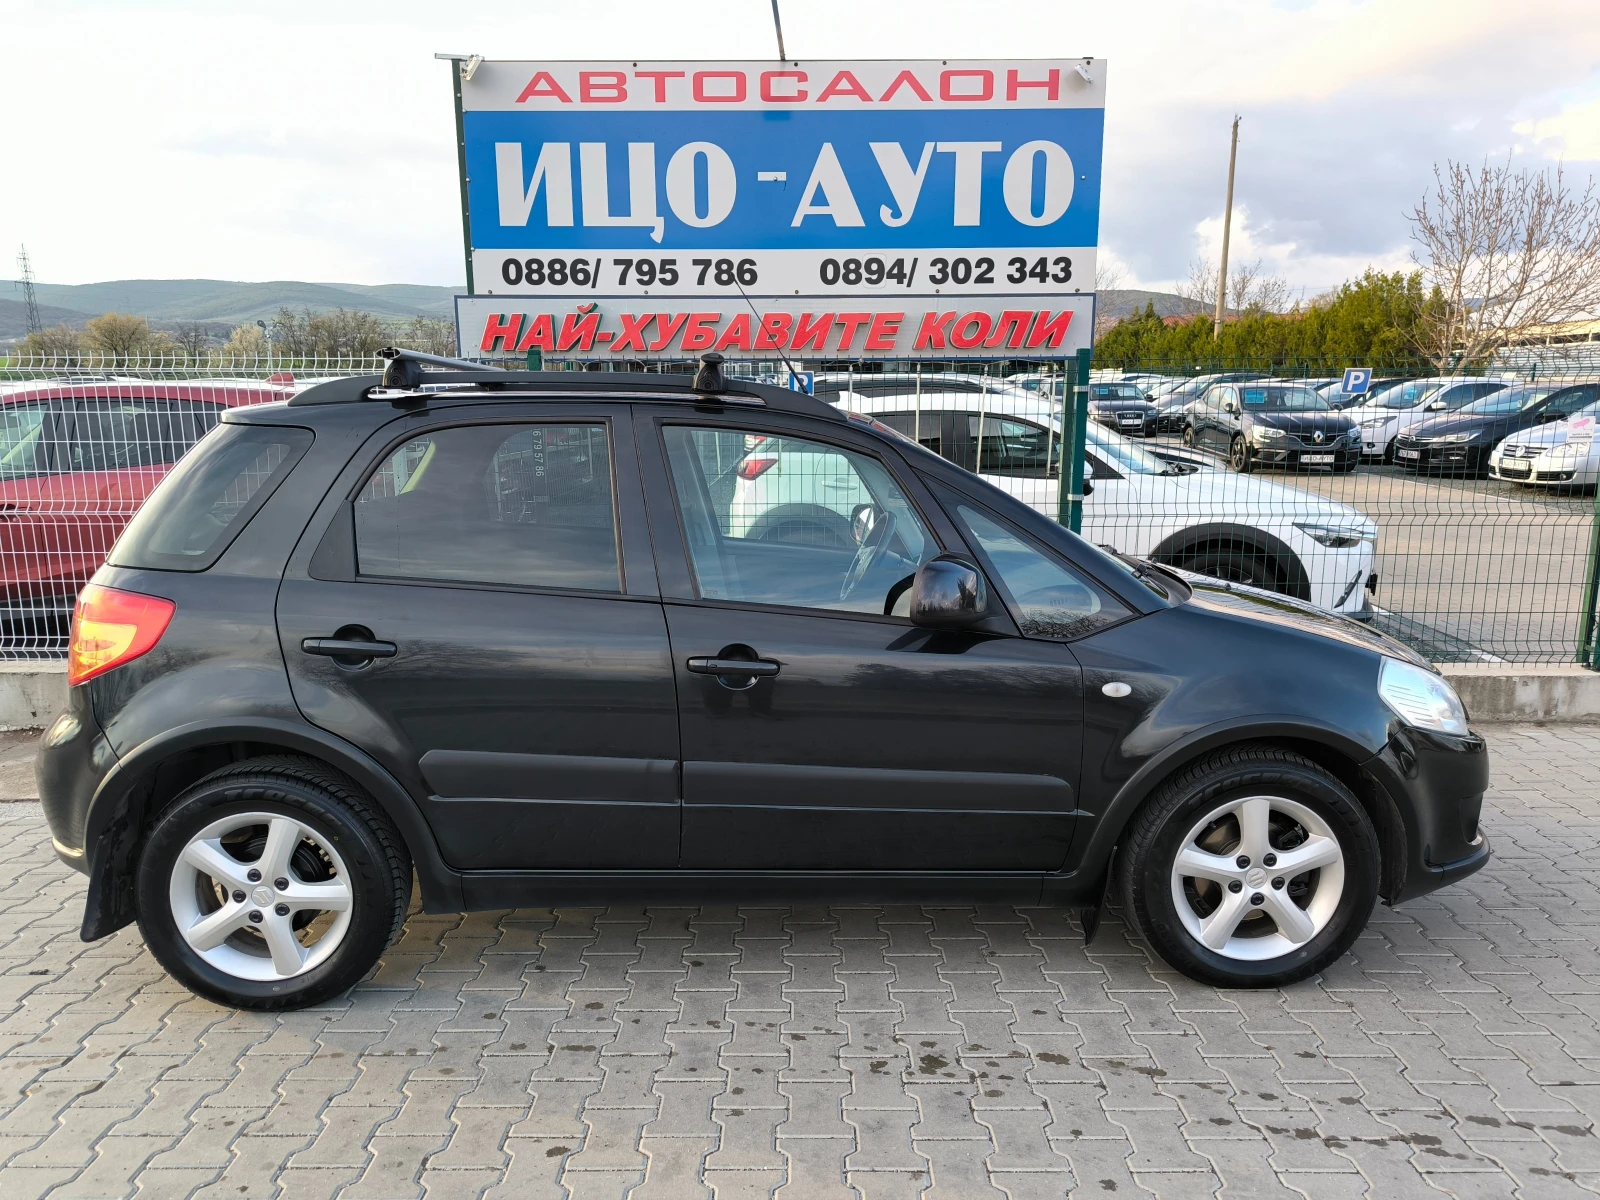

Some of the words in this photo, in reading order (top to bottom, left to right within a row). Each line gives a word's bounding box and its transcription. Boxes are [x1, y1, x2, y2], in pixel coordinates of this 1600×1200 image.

[516, 69, 1060, 103] АВТОСАЛОН
[495, 141, 737, 244] ИЦО
[501, 258, 602, 289] 0886/
[613, 258, 679, 286] 795
[692, 258, 758, 286] 786
[819, 258, 919, 288] 0894/
[928, 257, 995, 286] 302
[1006, 256, 1072, 284] 343
[479, 302, 905, 351] НАЙ-ХУБАВИТЕ
[912, 310, 1075, 350] КОЛИ
